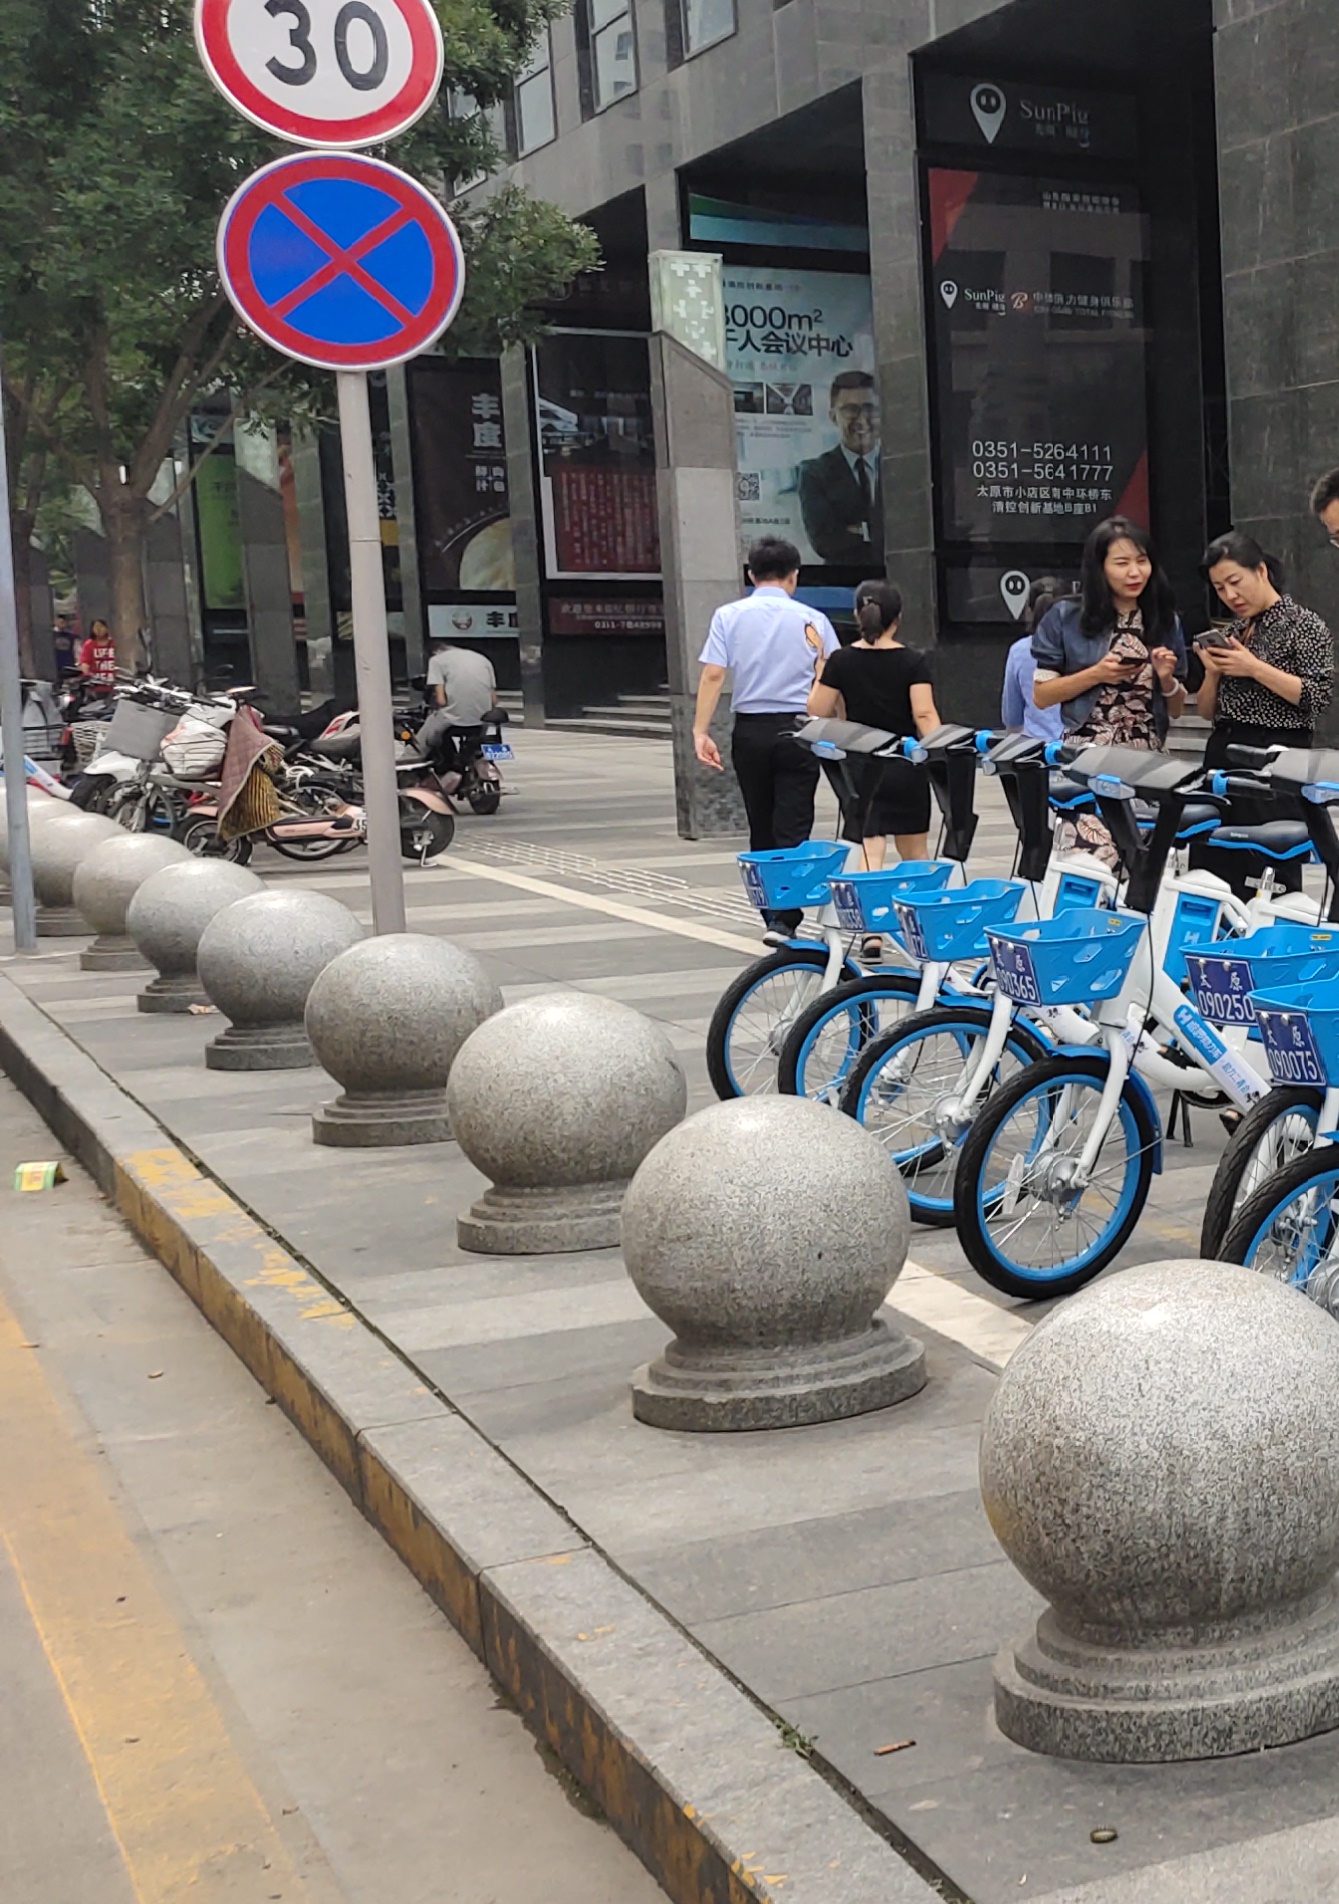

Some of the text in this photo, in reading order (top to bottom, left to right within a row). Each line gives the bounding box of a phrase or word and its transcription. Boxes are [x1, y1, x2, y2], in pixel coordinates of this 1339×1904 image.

[264, 0, 389, 91] 30
[1020, 99, 1090, 124] SunPig
[964, 288, 1006, 303] SunPig
[972, 440, 1112, 462] 0351-5264111
[972, 461, 1114, 482] 0351-5641777
[997, 967, 1036, 1001] 090365
[1200, 968, 1243, 991] 太原
[1198, 989, 1256, 1021] 090250
[1266, 1024, 1306, 1048] 太原
[1267, 1048, 1319, 1080] 090075
